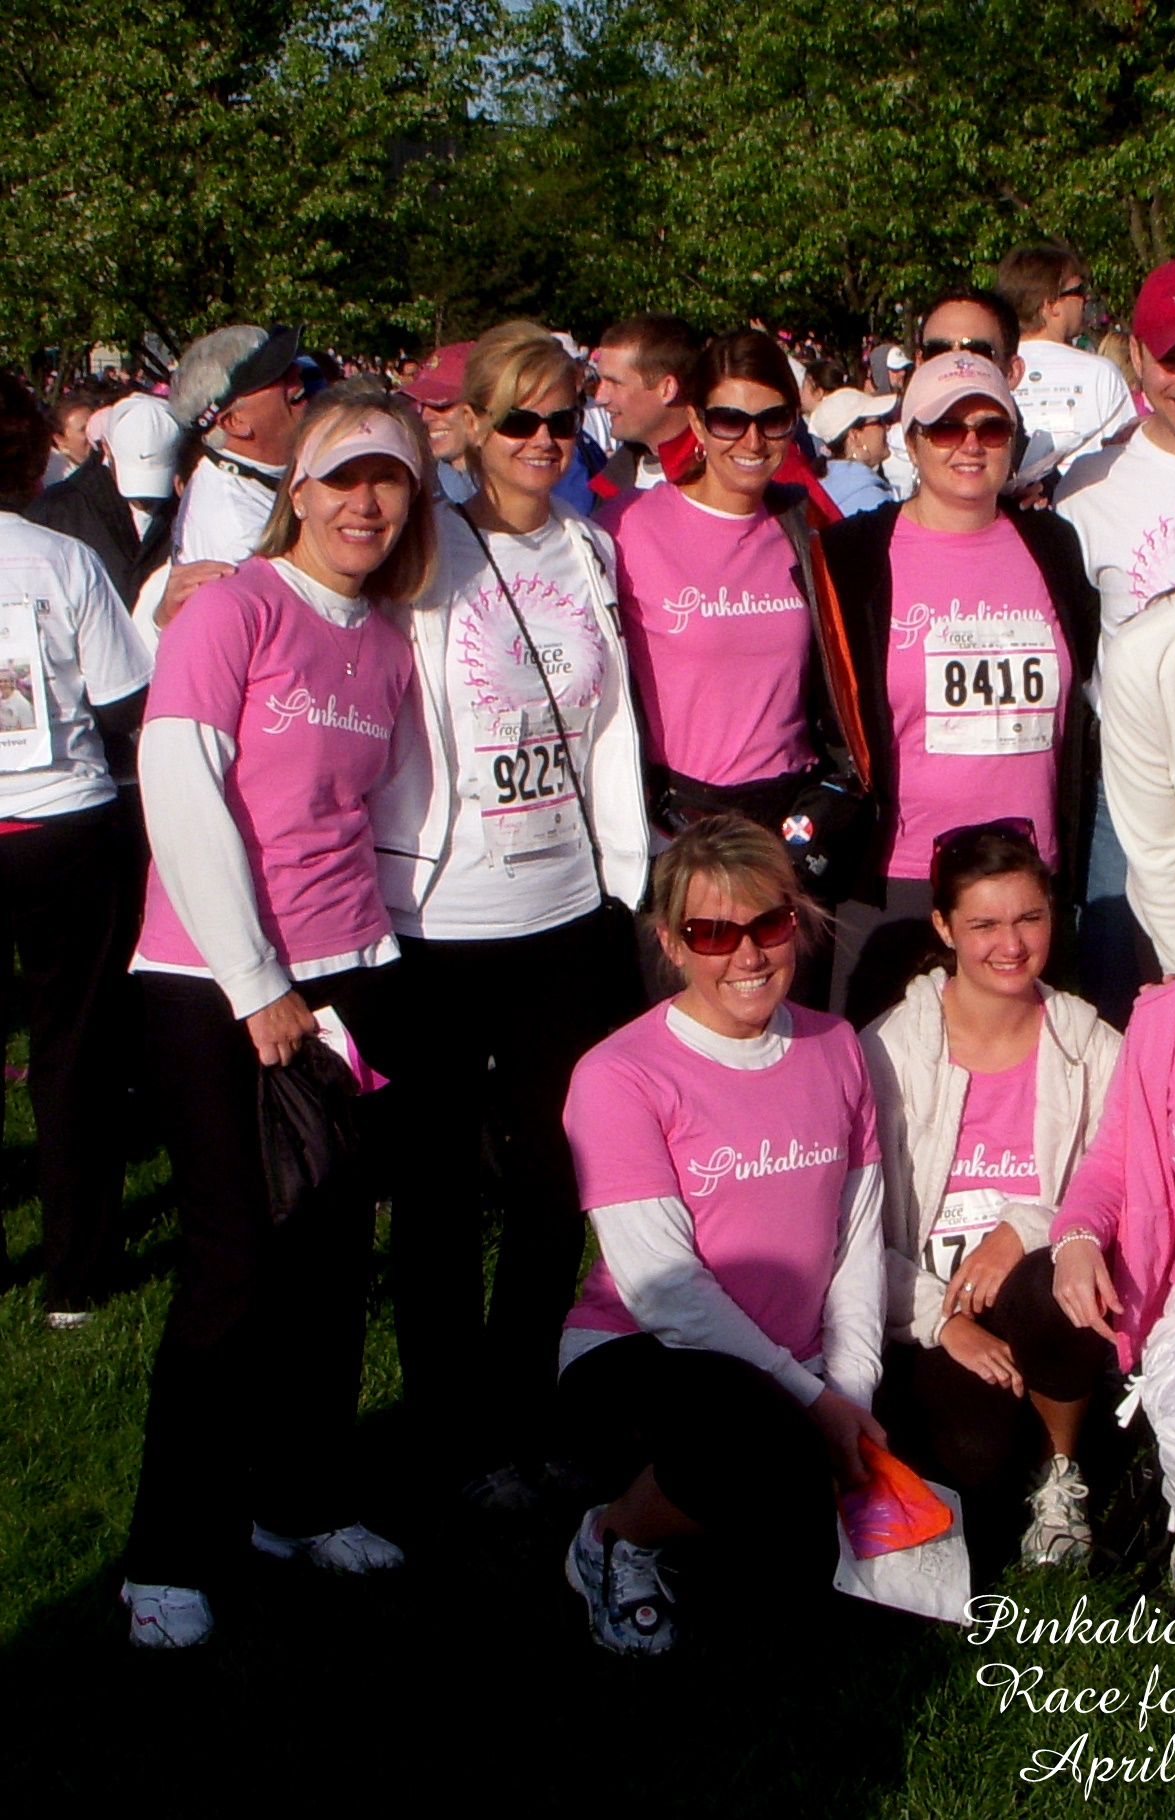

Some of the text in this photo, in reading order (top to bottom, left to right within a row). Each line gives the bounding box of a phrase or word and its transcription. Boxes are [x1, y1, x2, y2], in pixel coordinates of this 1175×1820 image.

[546, 662, 573, 675] ure
[945, 657, 1043, 707] 8416
[493, 741, 568, 805] 9225
[687, 1139, 846, 1197] Pinkalicio
[951, 1143, 1038, 1178] nkalici
